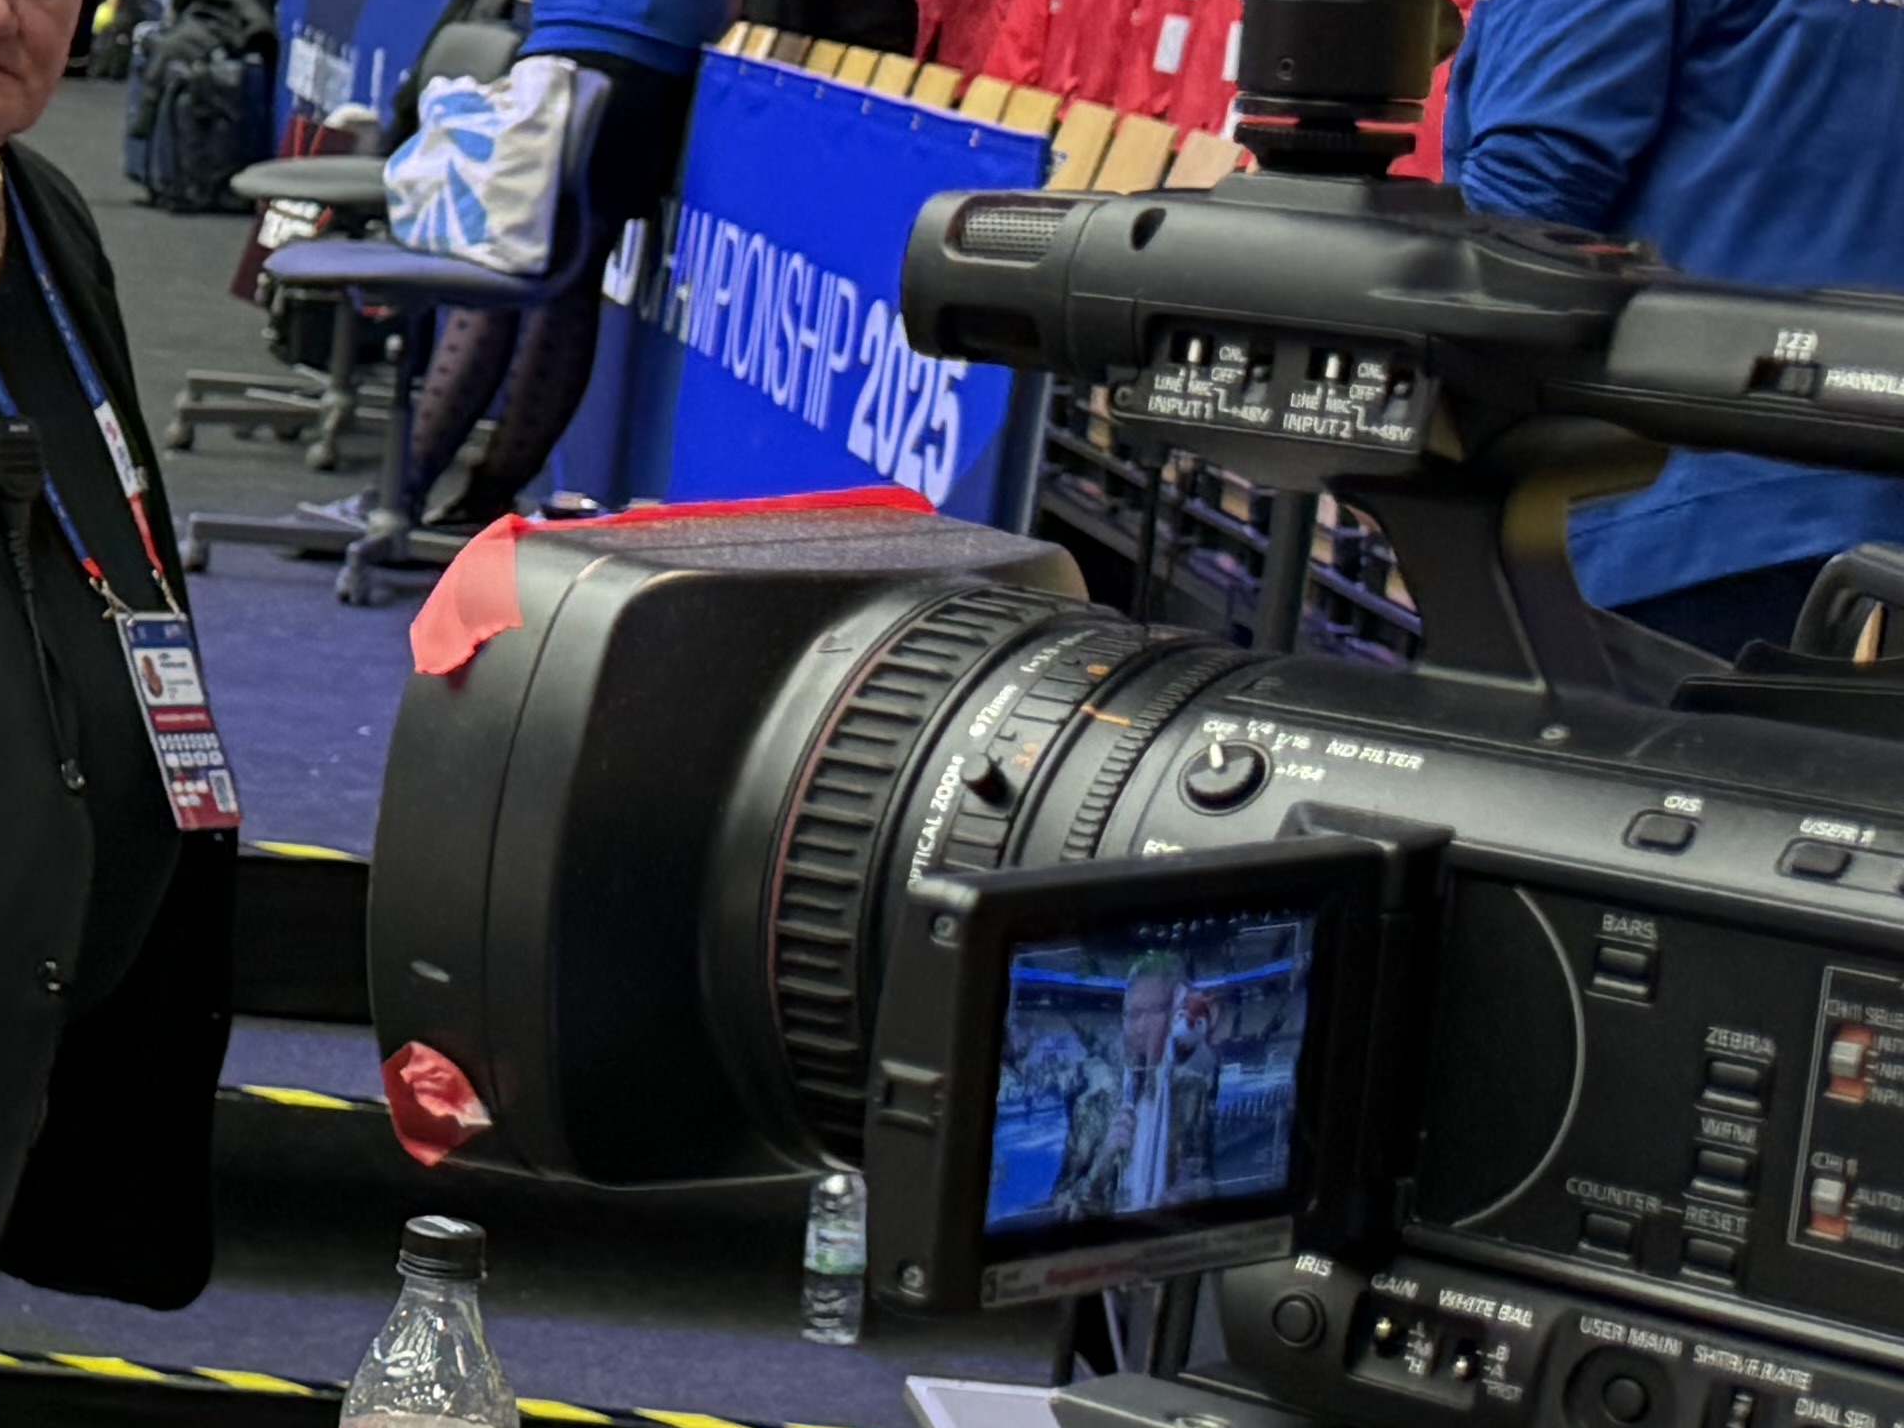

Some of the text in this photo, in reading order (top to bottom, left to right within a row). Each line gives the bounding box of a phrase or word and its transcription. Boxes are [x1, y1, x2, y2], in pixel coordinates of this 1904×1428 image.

[847, 299, 967, 507] 2025
[1148, 394, 1203, 419] INPUT
[1290, 391, 1321, 411] LINE
[1283, 412, 1339, 435] INPUT
[1358, 746, 1425, 772] FILTER
[1601, 912, 1659, 940] BARS
[1704, 1025, 1776, 1057] ZEBRA
[1565, 1177, 1749, 1235] COUNTER RESET
[1294, 1253, 1334, 1277] IRIS
[1370, 1274, 1421, 1298] GAIN
[1438, 1289, 1534, 1329] WHITE BAL
[1578, 1316, 1684, 1357] USER MAIN
[1793, 1398, 1841, 1426] DIAL
